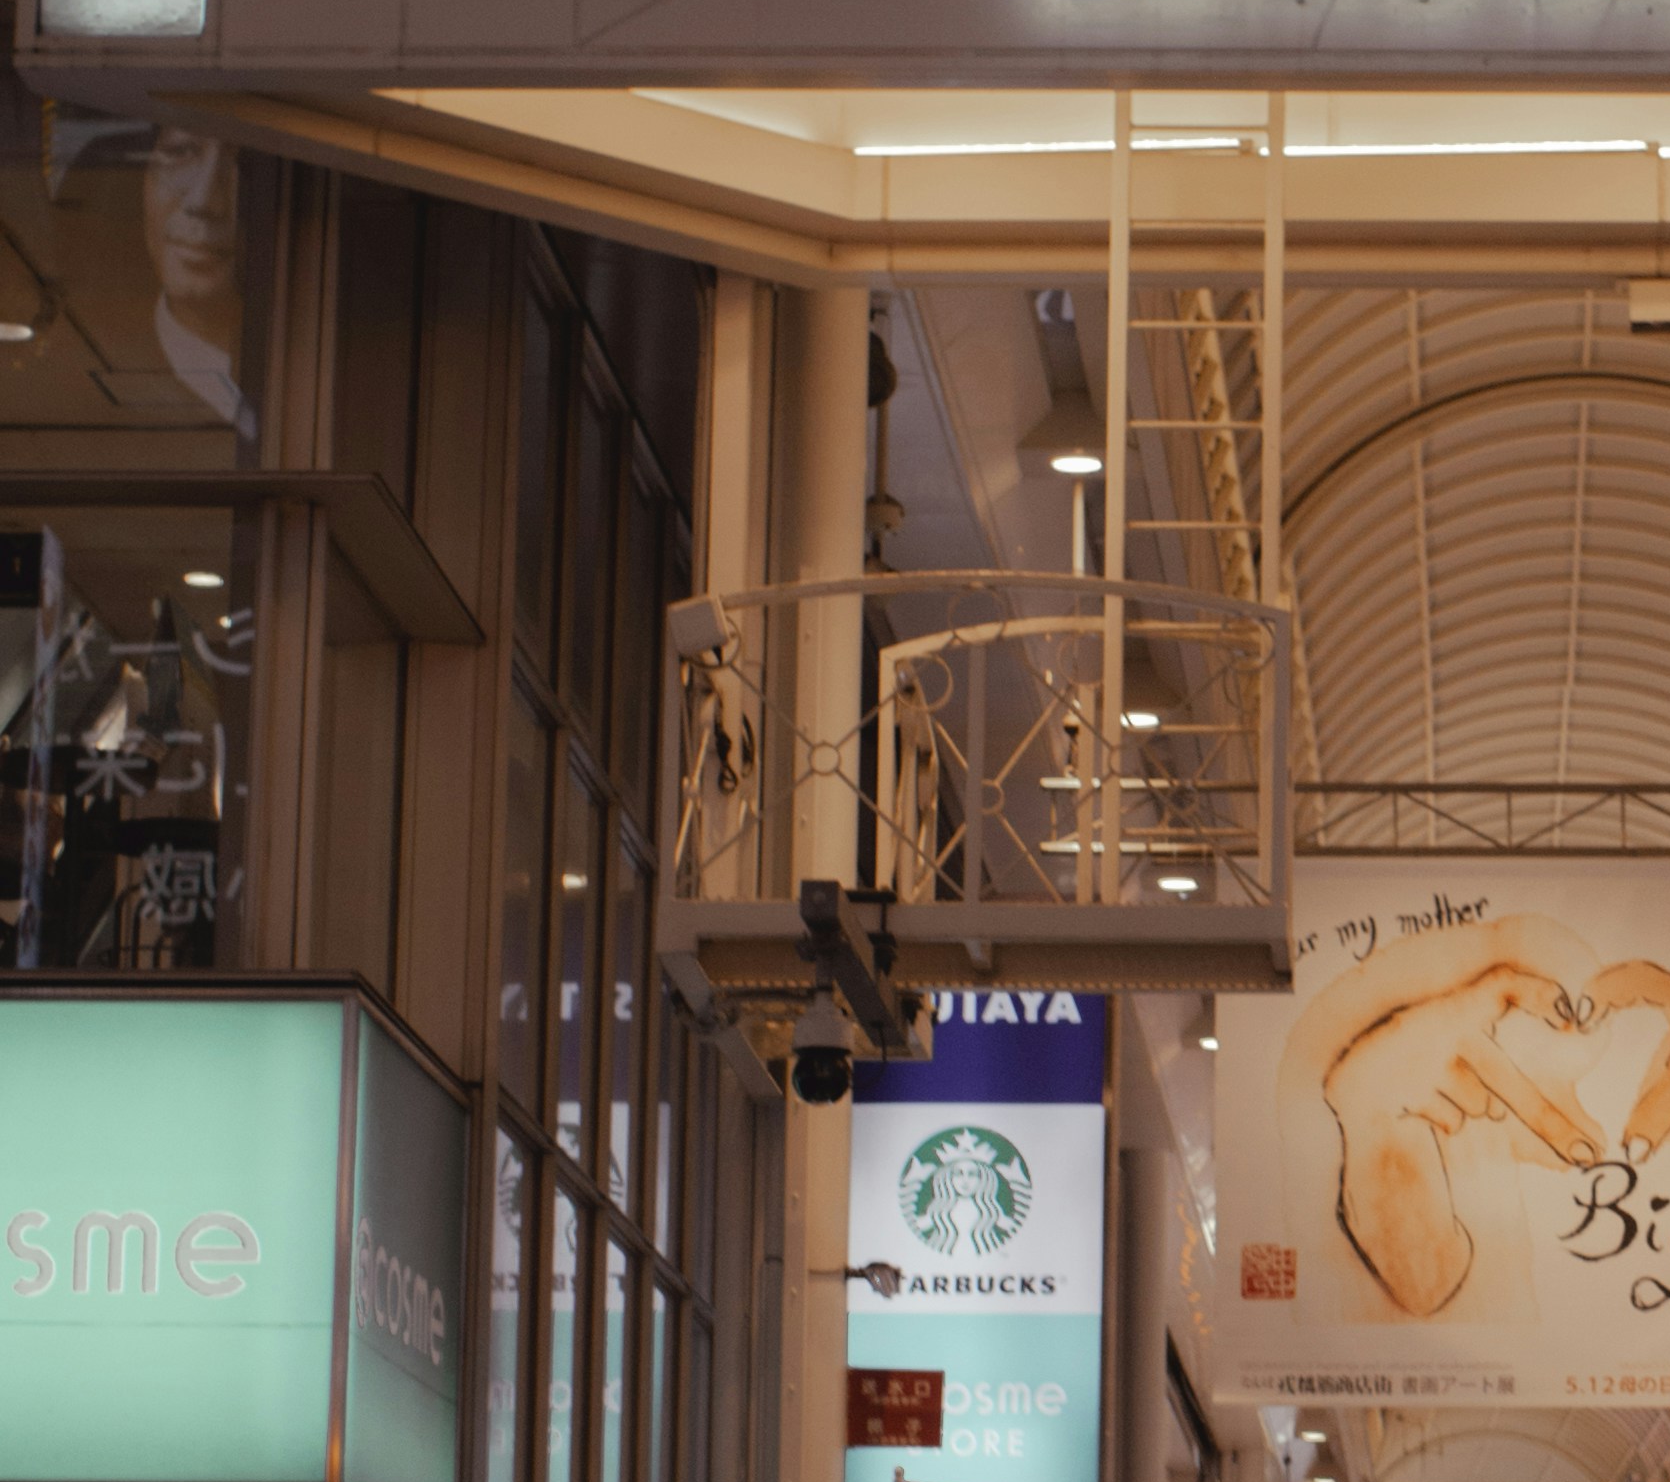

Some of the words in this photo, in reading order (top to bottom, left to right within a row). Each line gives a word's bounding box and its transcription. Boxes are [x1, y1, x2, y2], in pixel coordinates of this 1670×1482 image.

[1336, 915, 1379, 962] my
[1396, 892, 1490, 935] mother
[902, 1273, 1058, 1296] ARBUCKS
